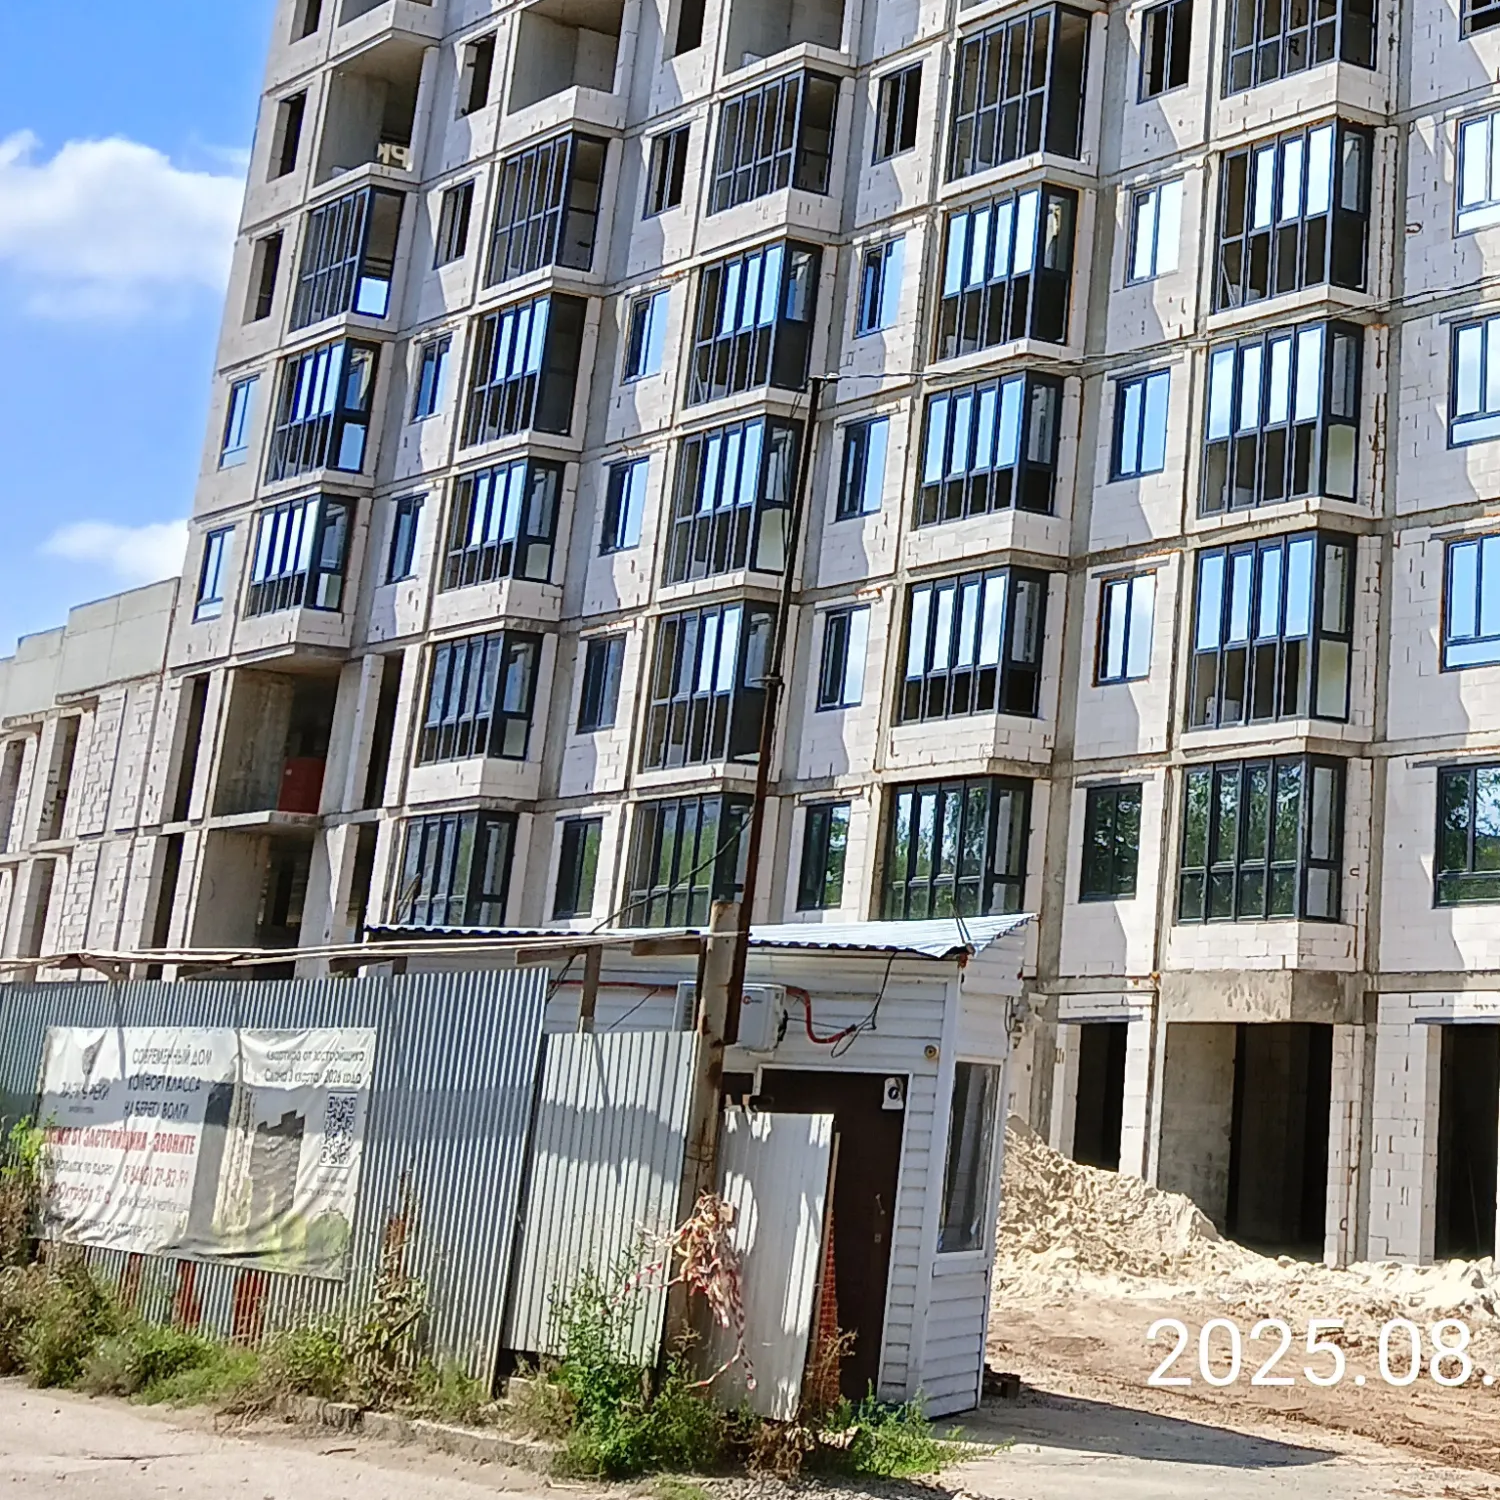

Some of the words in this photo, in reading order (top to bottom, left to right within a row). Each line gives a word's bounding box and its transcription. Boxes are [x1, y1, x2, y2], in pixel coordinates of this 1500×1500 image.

[165, 1074, 201, 1094] КЛАССА
[161, 1101, 190, 1120] ВОЛГИ
[152, 1131, 197, 1155] ЗВОНИТЕ
